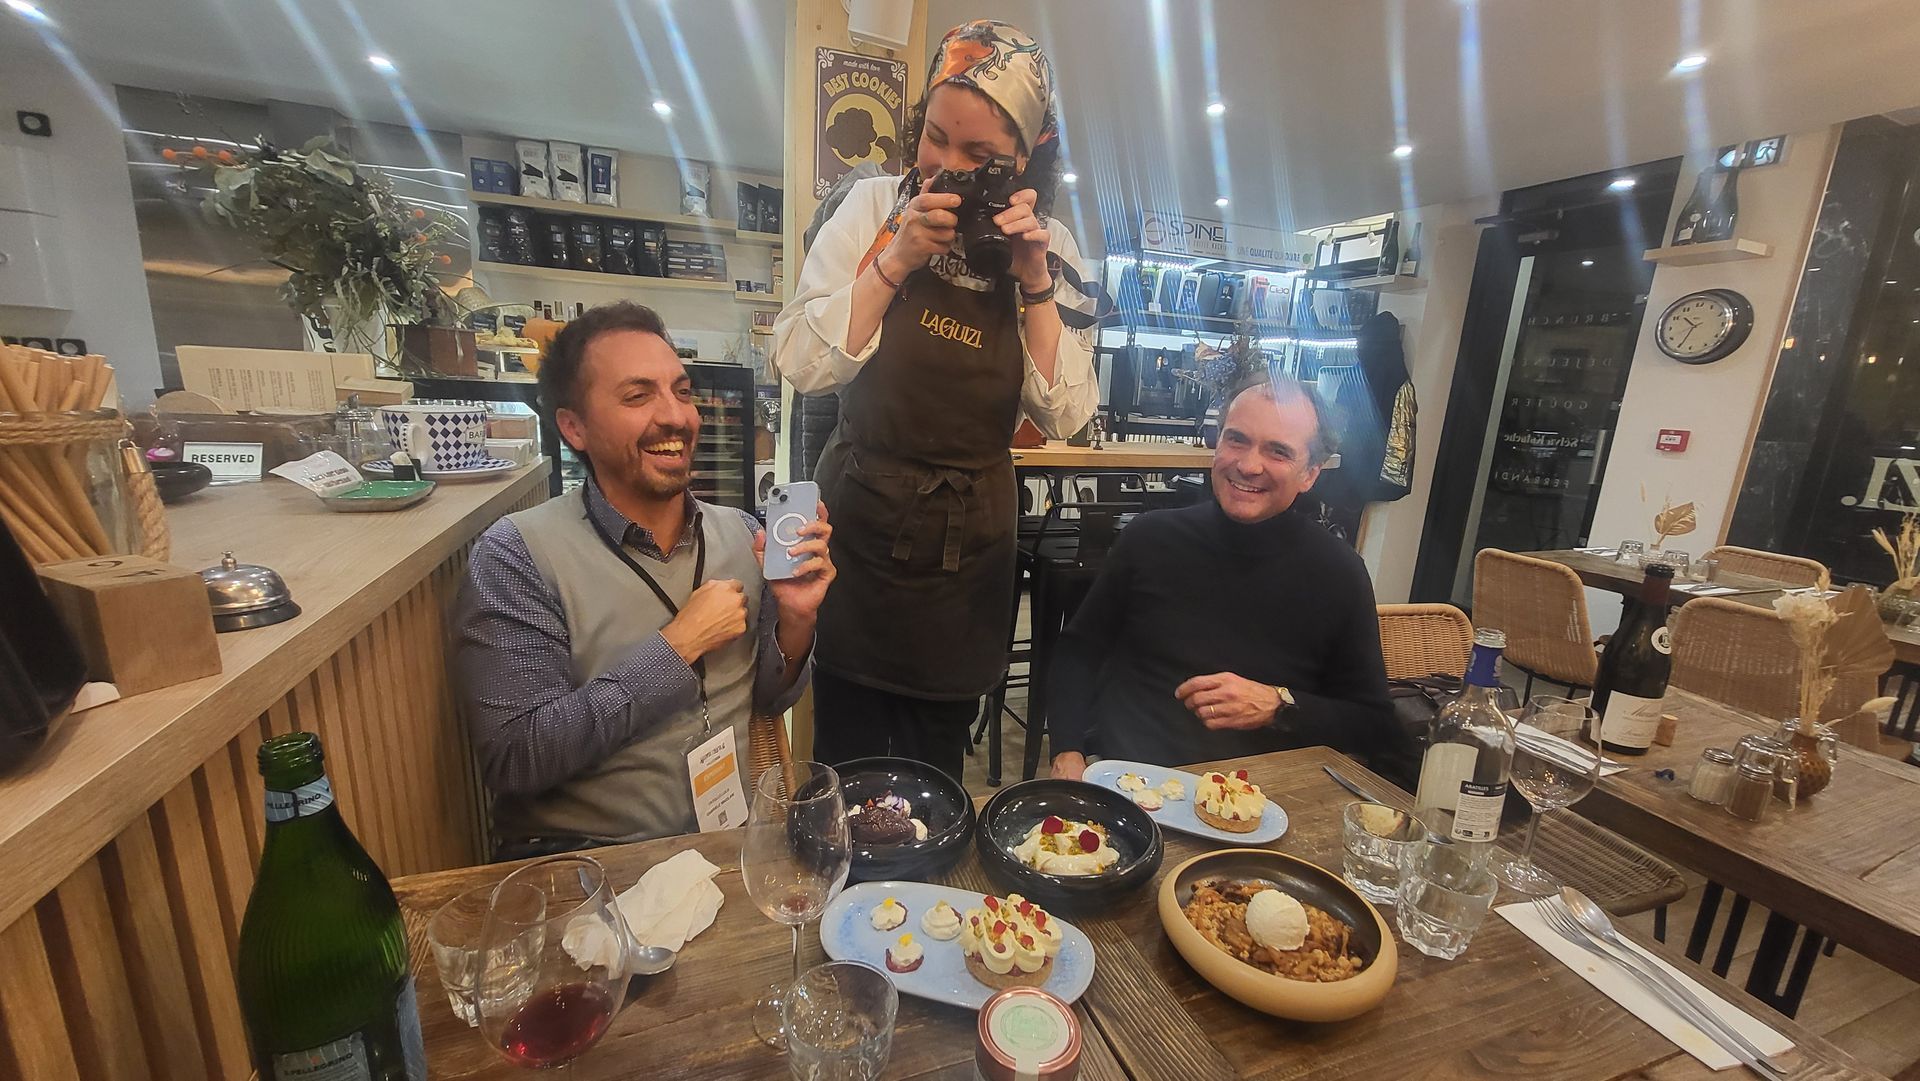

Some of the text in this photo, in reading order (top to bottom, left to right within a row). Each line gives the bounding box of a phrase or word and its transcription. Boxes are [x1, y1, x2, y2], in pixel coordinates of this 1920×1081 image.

[823, 71, 902, 110] BEST COOKIES
[1168, 220, 1233, 244] SPINEL
[191, 454, 255, 463] RESERVED
